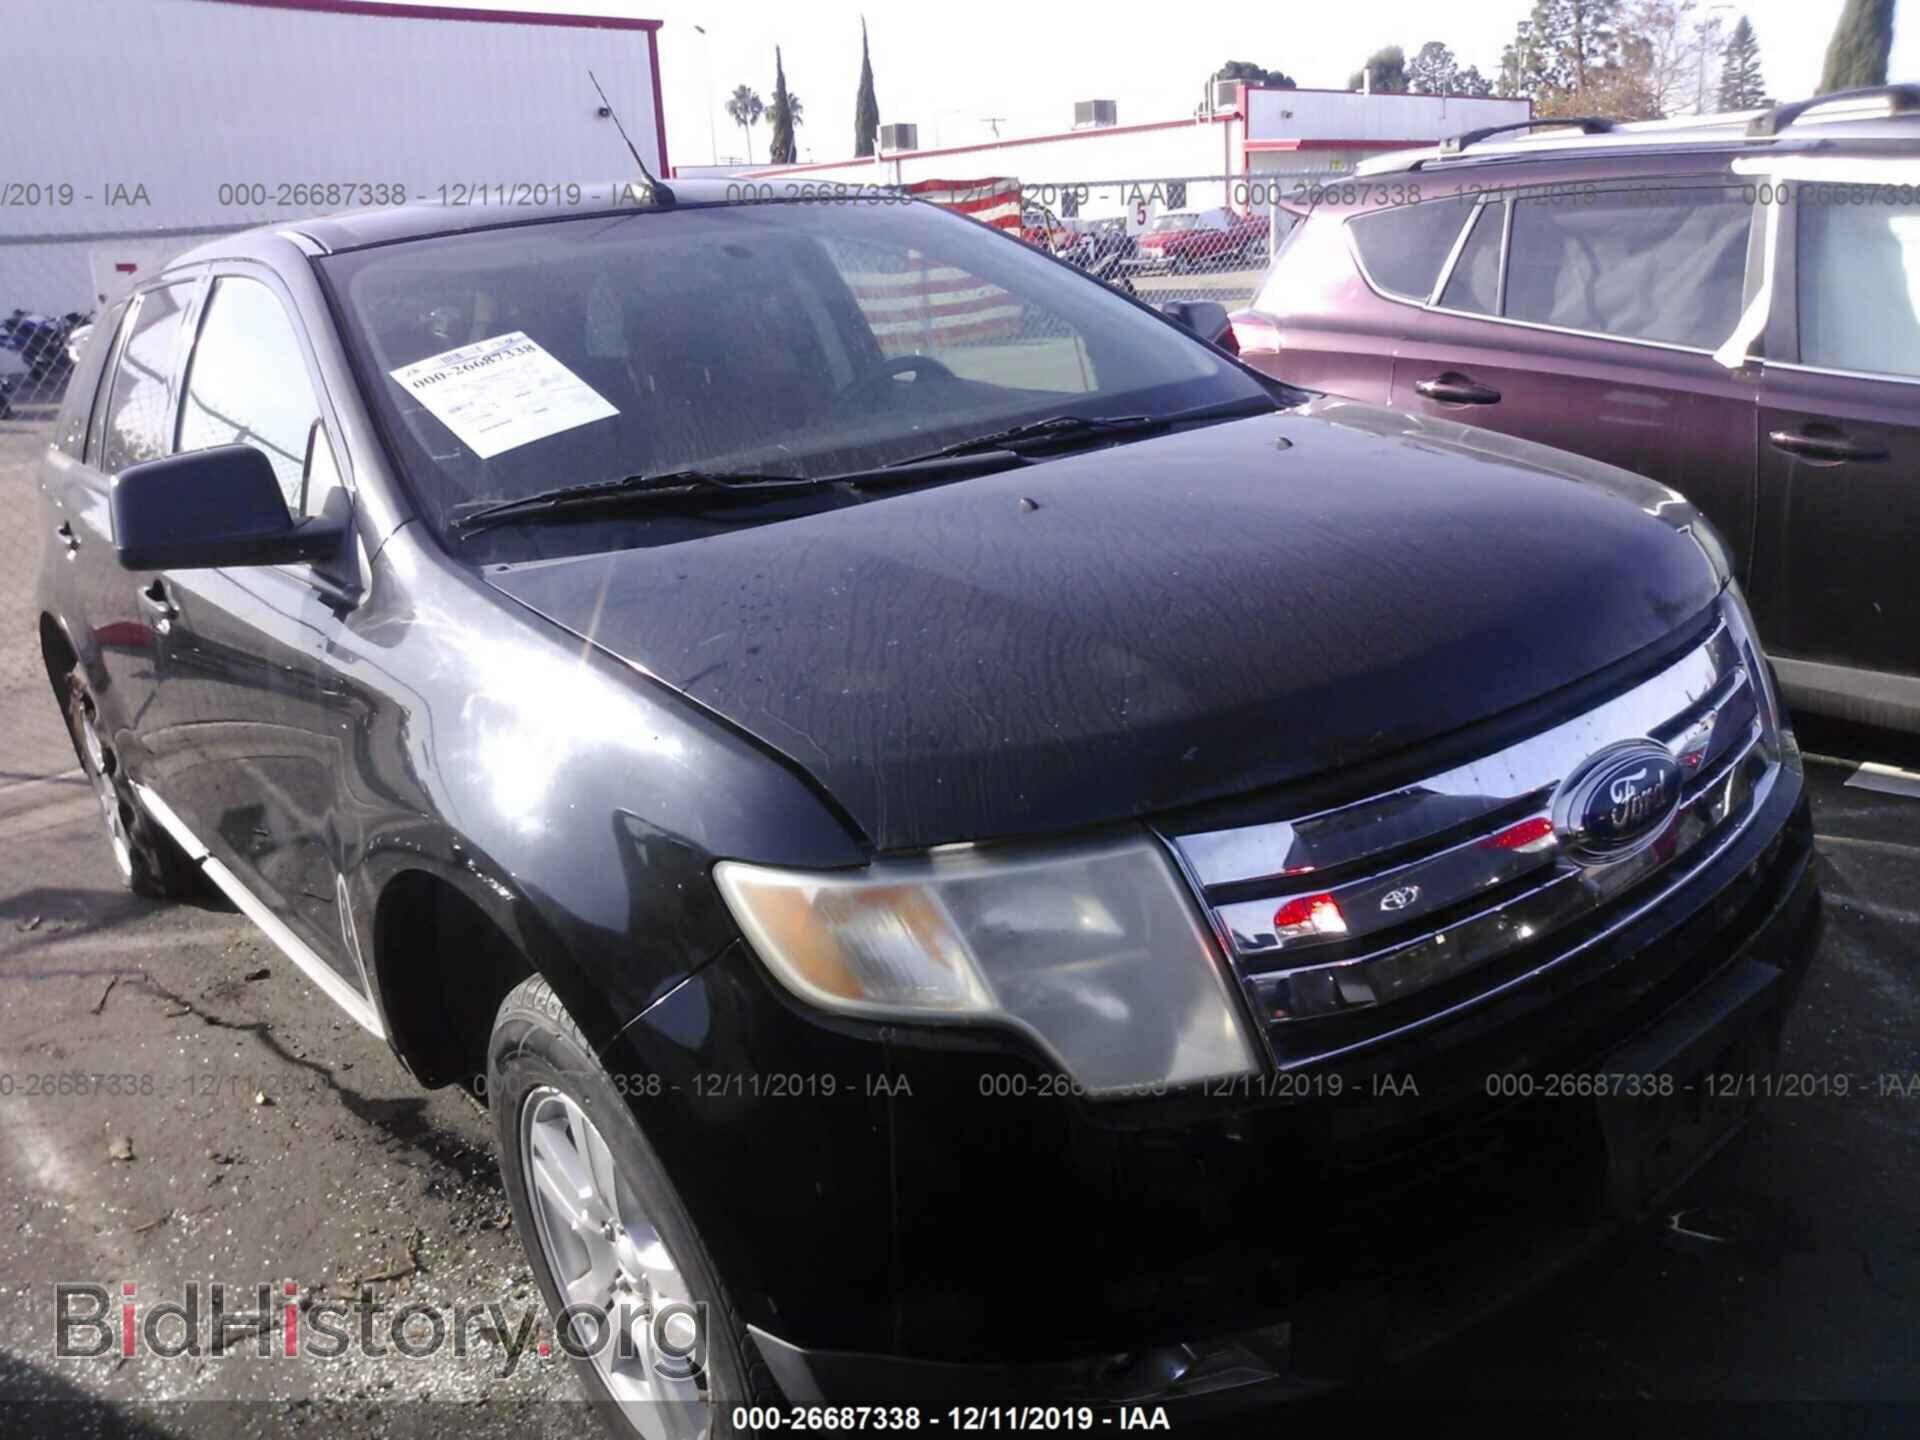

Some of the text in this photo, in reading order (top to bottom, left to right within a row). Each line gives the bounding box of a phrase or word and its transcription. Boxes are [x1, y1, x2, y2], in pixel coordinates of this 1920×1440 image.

[1137, 202, 1146, 226] 5
[412, 343, 537, 390] 000-26687338
[1610, 767, 1665, 827] Ford
